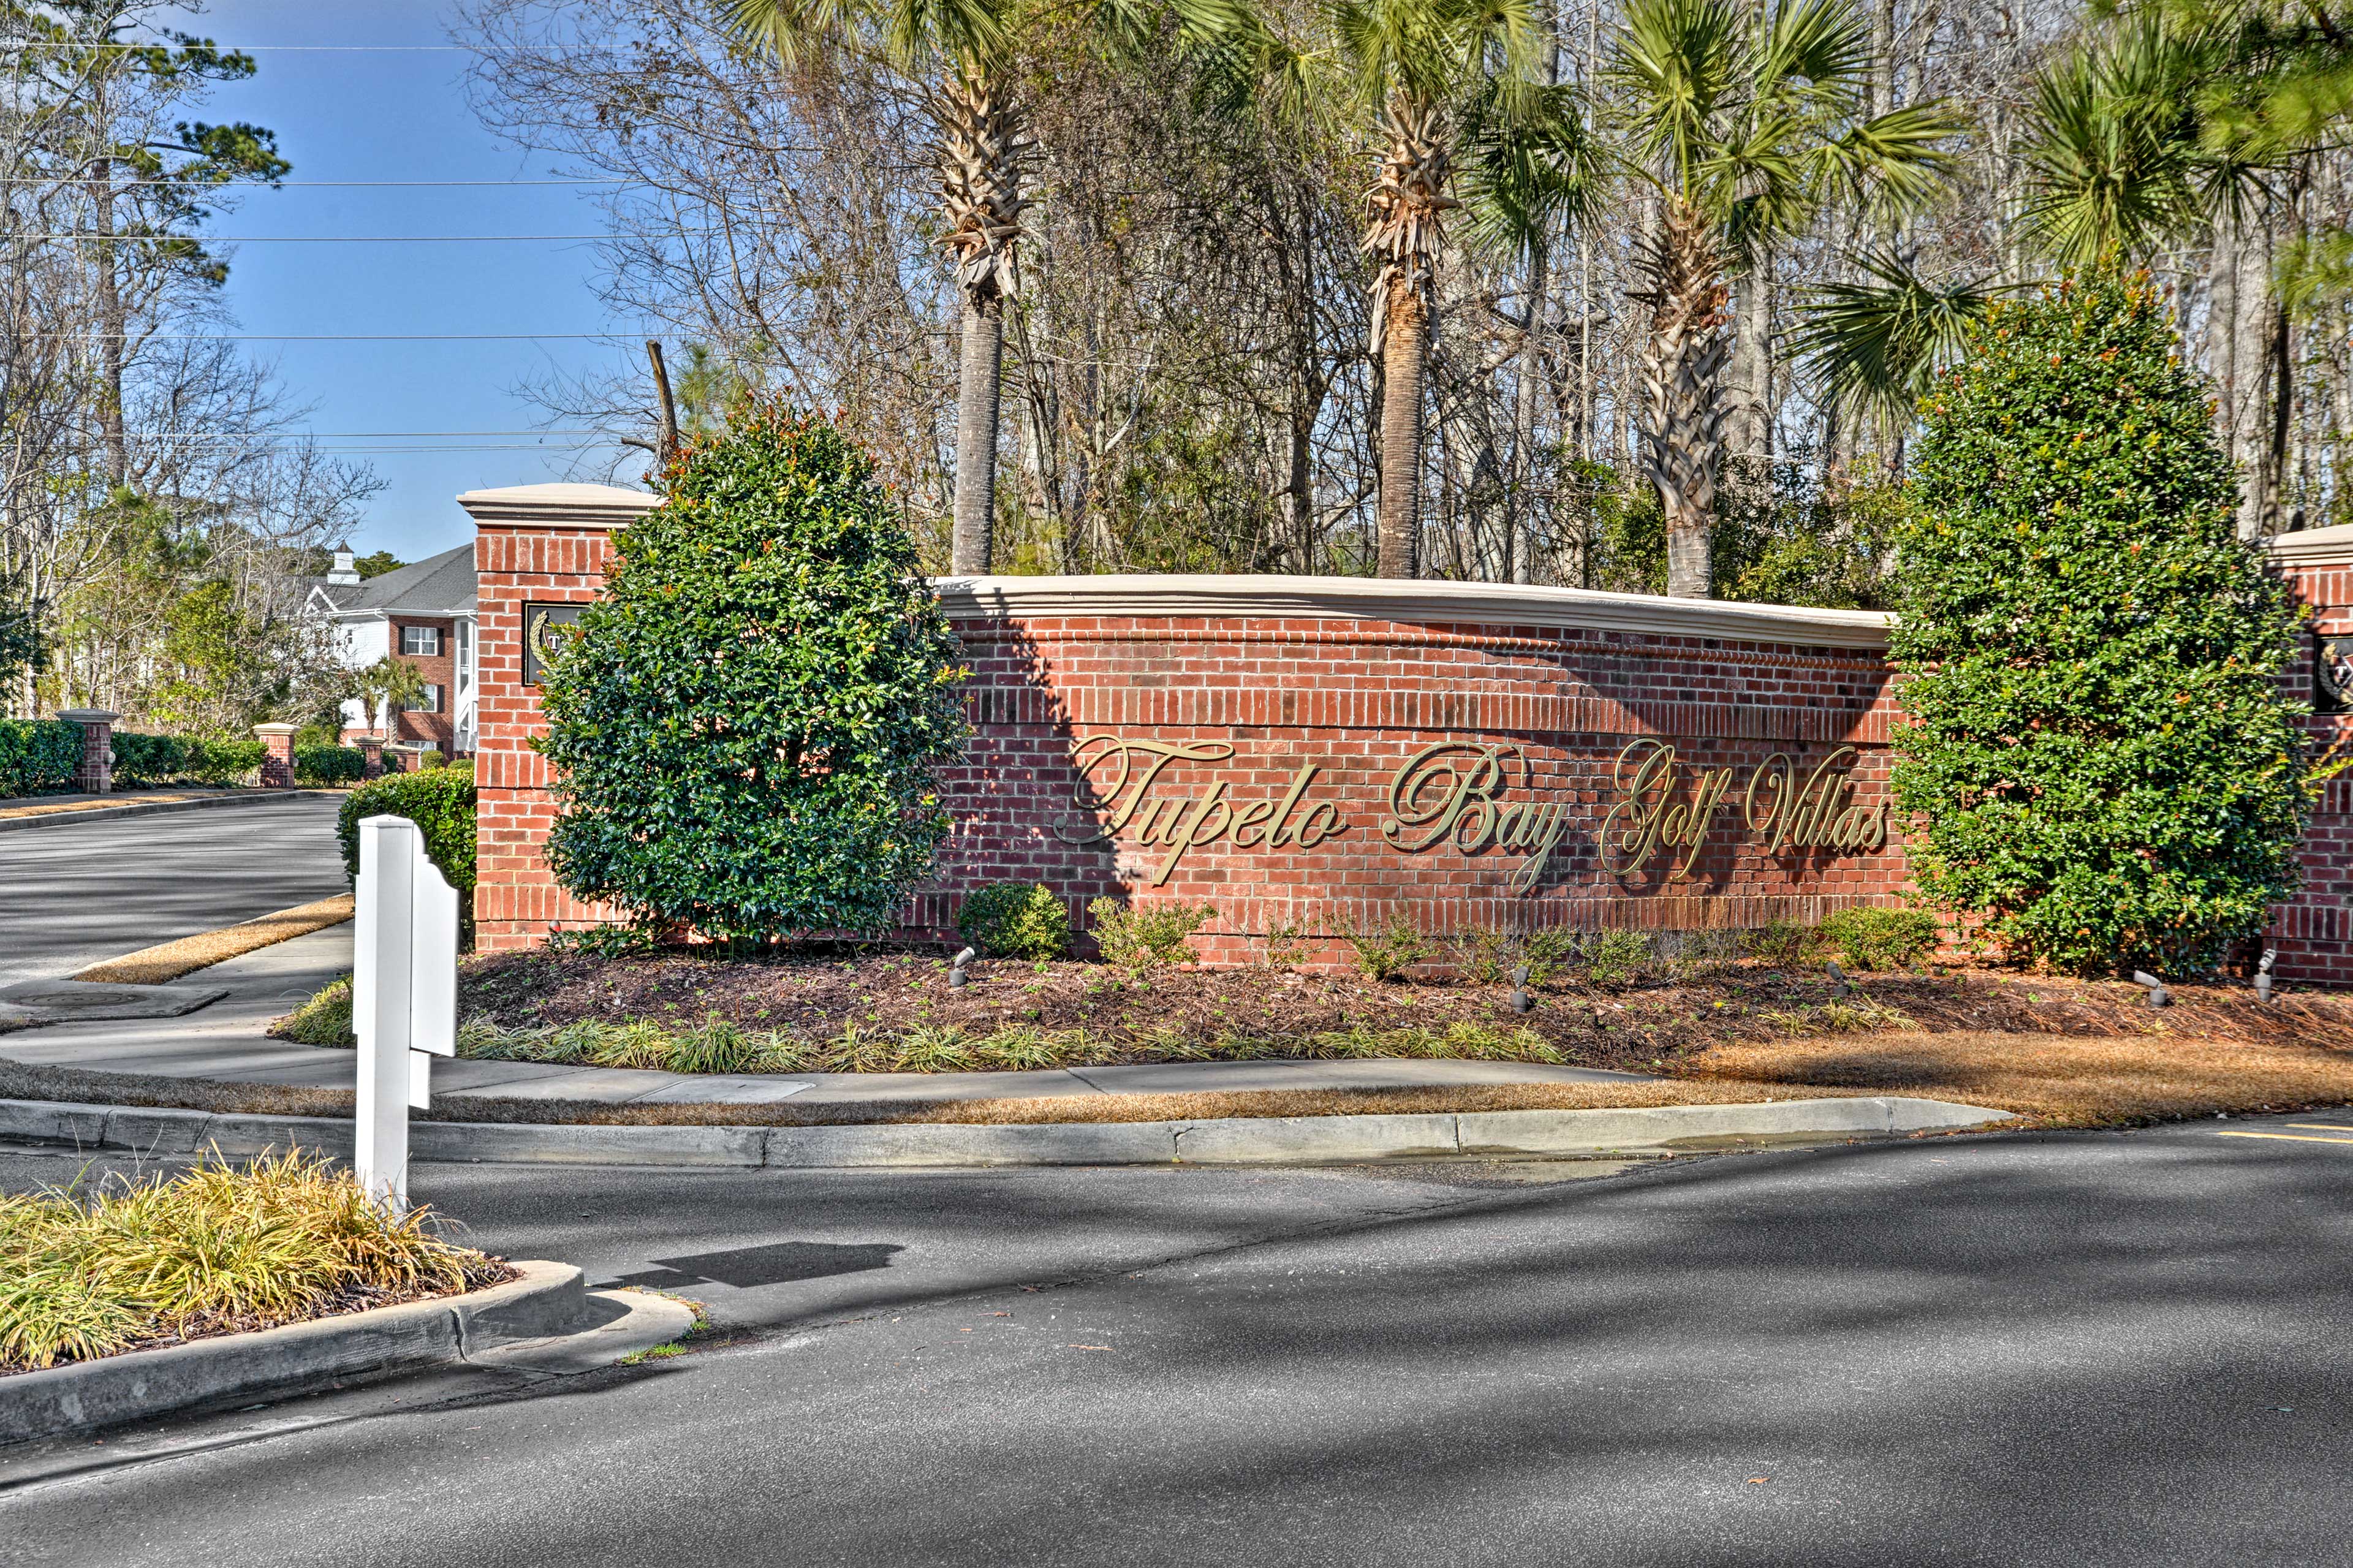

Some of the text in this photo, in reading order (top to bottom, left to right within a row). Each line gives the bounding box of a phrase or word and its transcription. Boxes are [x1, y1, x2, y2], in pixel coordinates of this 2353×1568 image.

[1053, 733, 1889, 895] Tupelo Bay Golf Villas
